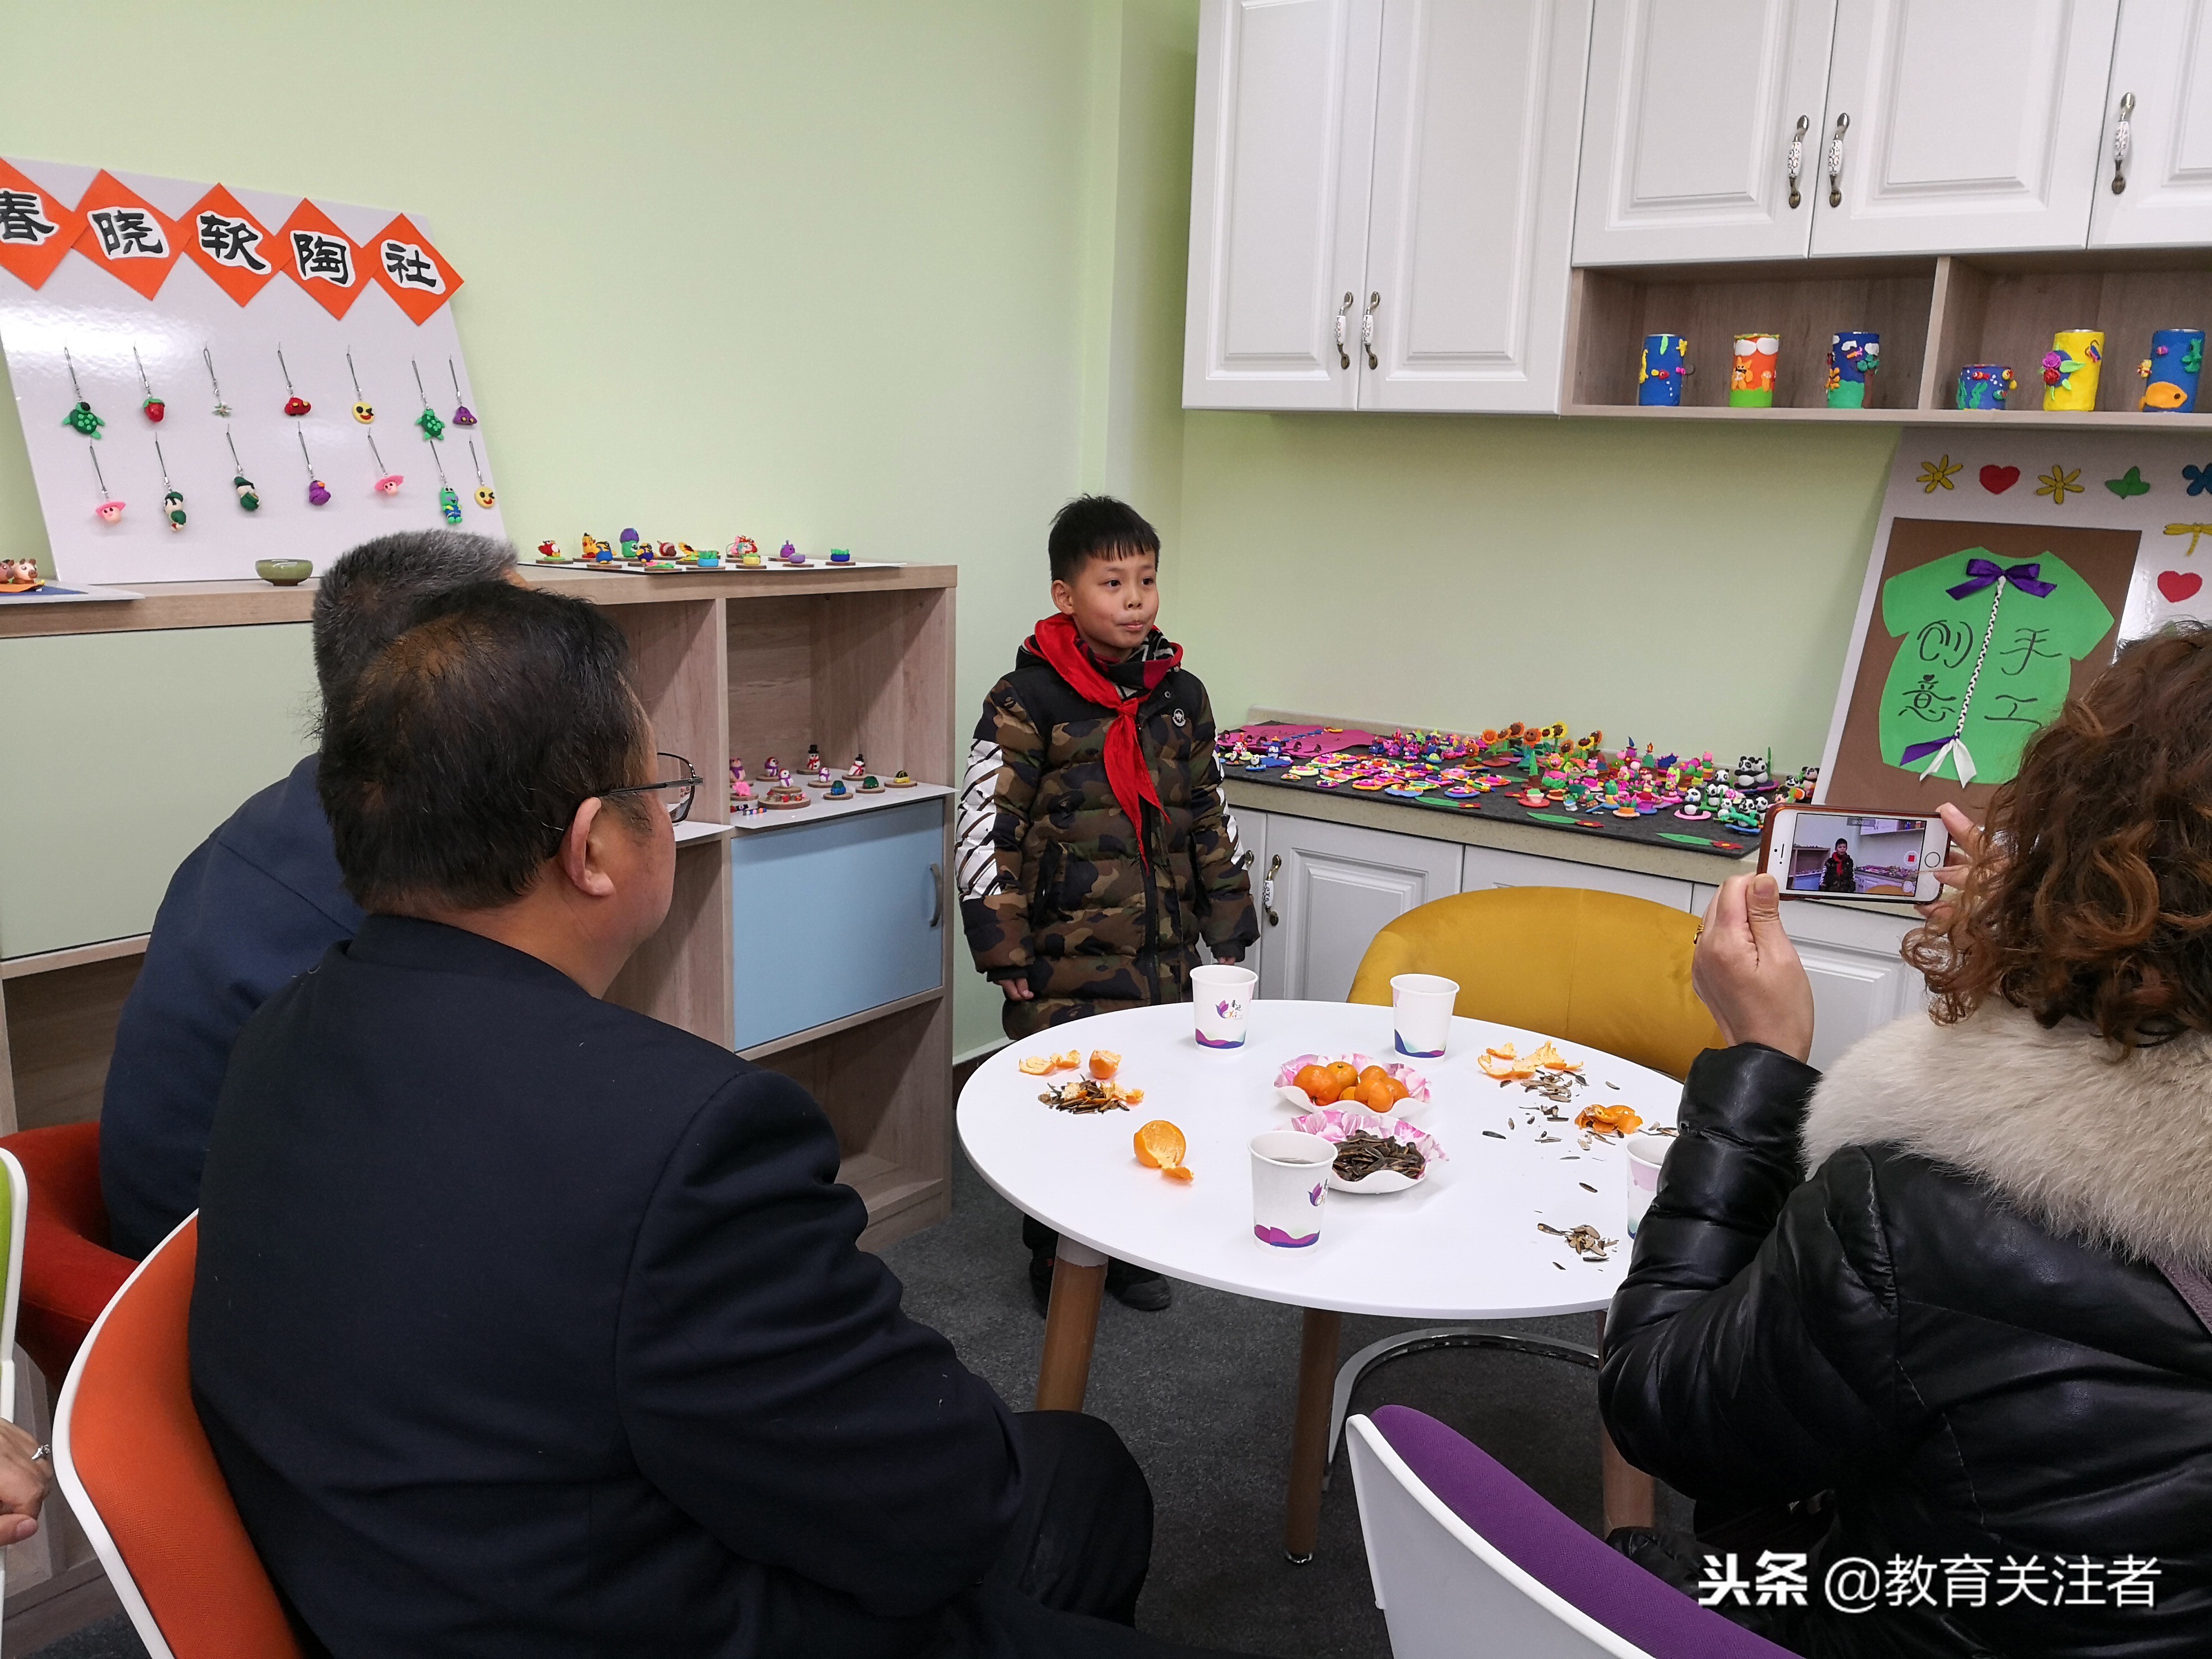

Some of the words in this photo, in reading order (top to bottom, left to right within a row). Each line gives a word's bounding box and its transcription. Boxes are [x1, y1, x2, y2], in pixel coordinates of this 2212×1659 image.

[0, 190, 436, 288] 春晓软陶社
